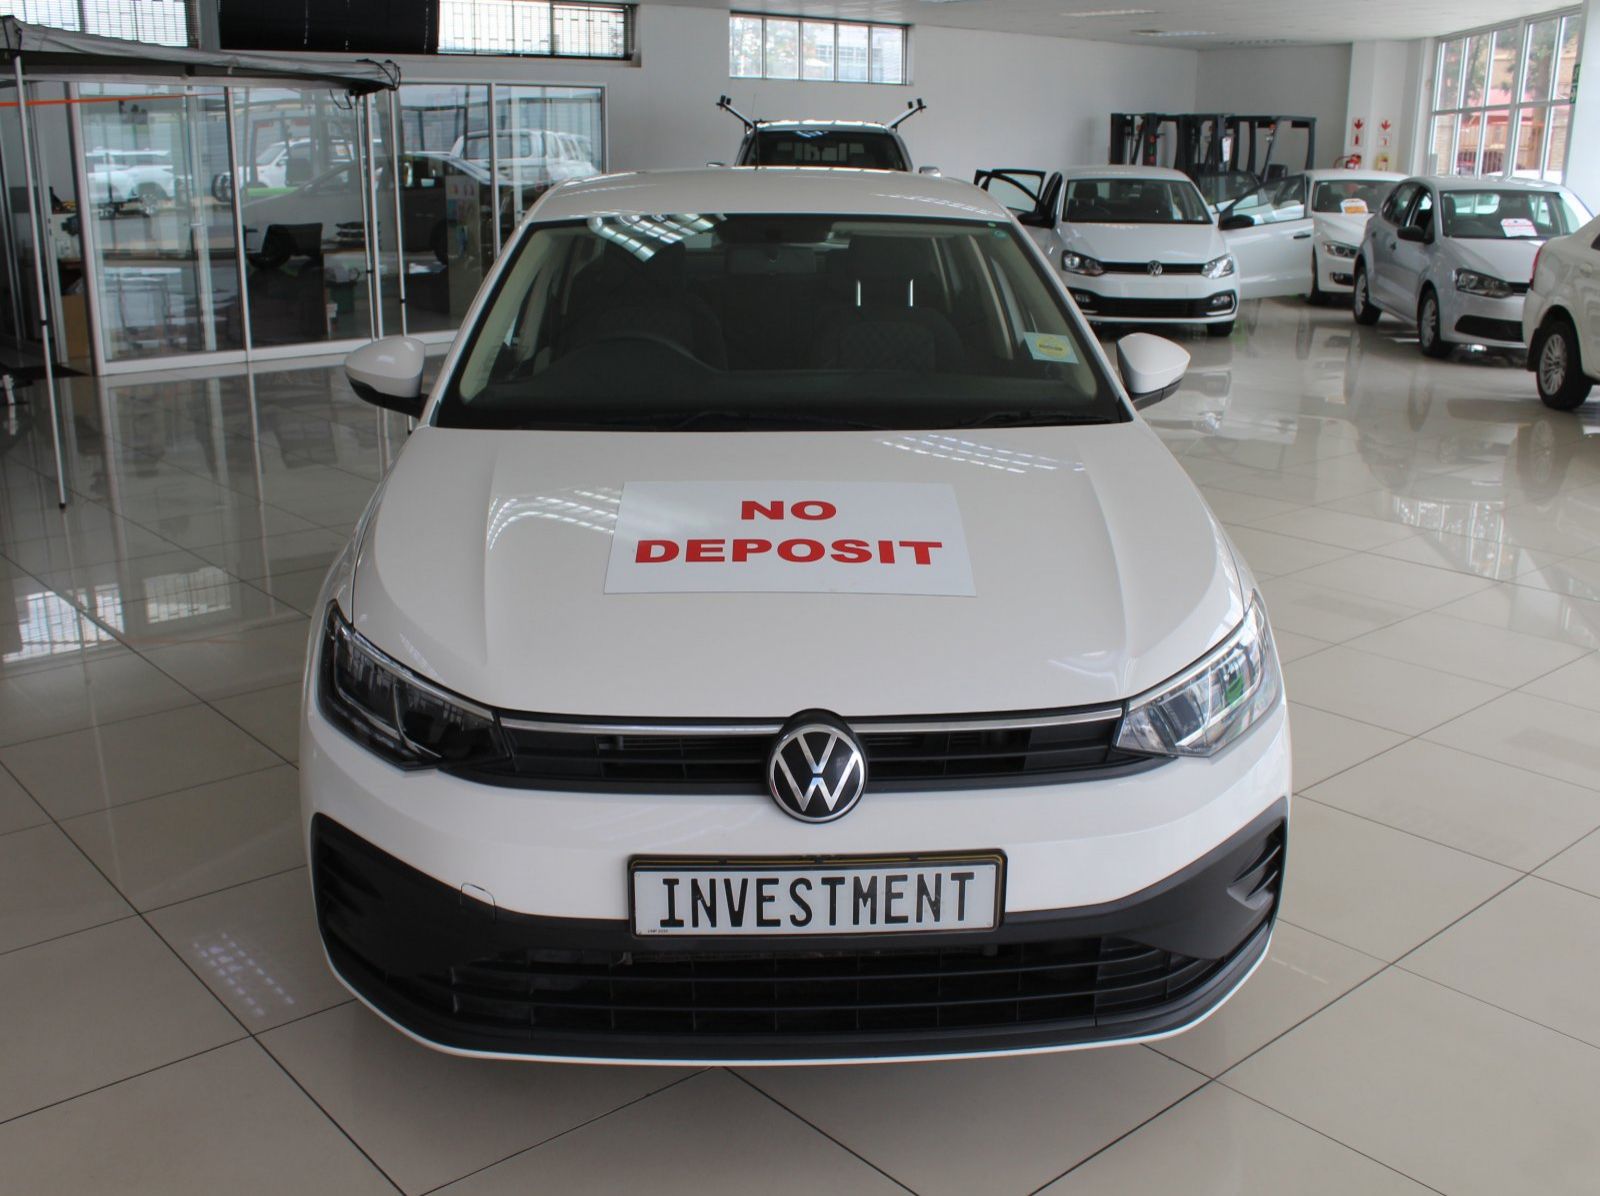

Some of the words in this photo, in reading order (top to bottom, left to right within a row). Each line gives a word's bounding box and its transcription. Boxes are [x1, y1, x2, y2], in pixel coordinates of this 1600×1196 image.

[741, 500, 837, 521] NO
[635, 538, 943, 565] DEPOSIT
[659, 871, 975, 928] INVESTMENT
